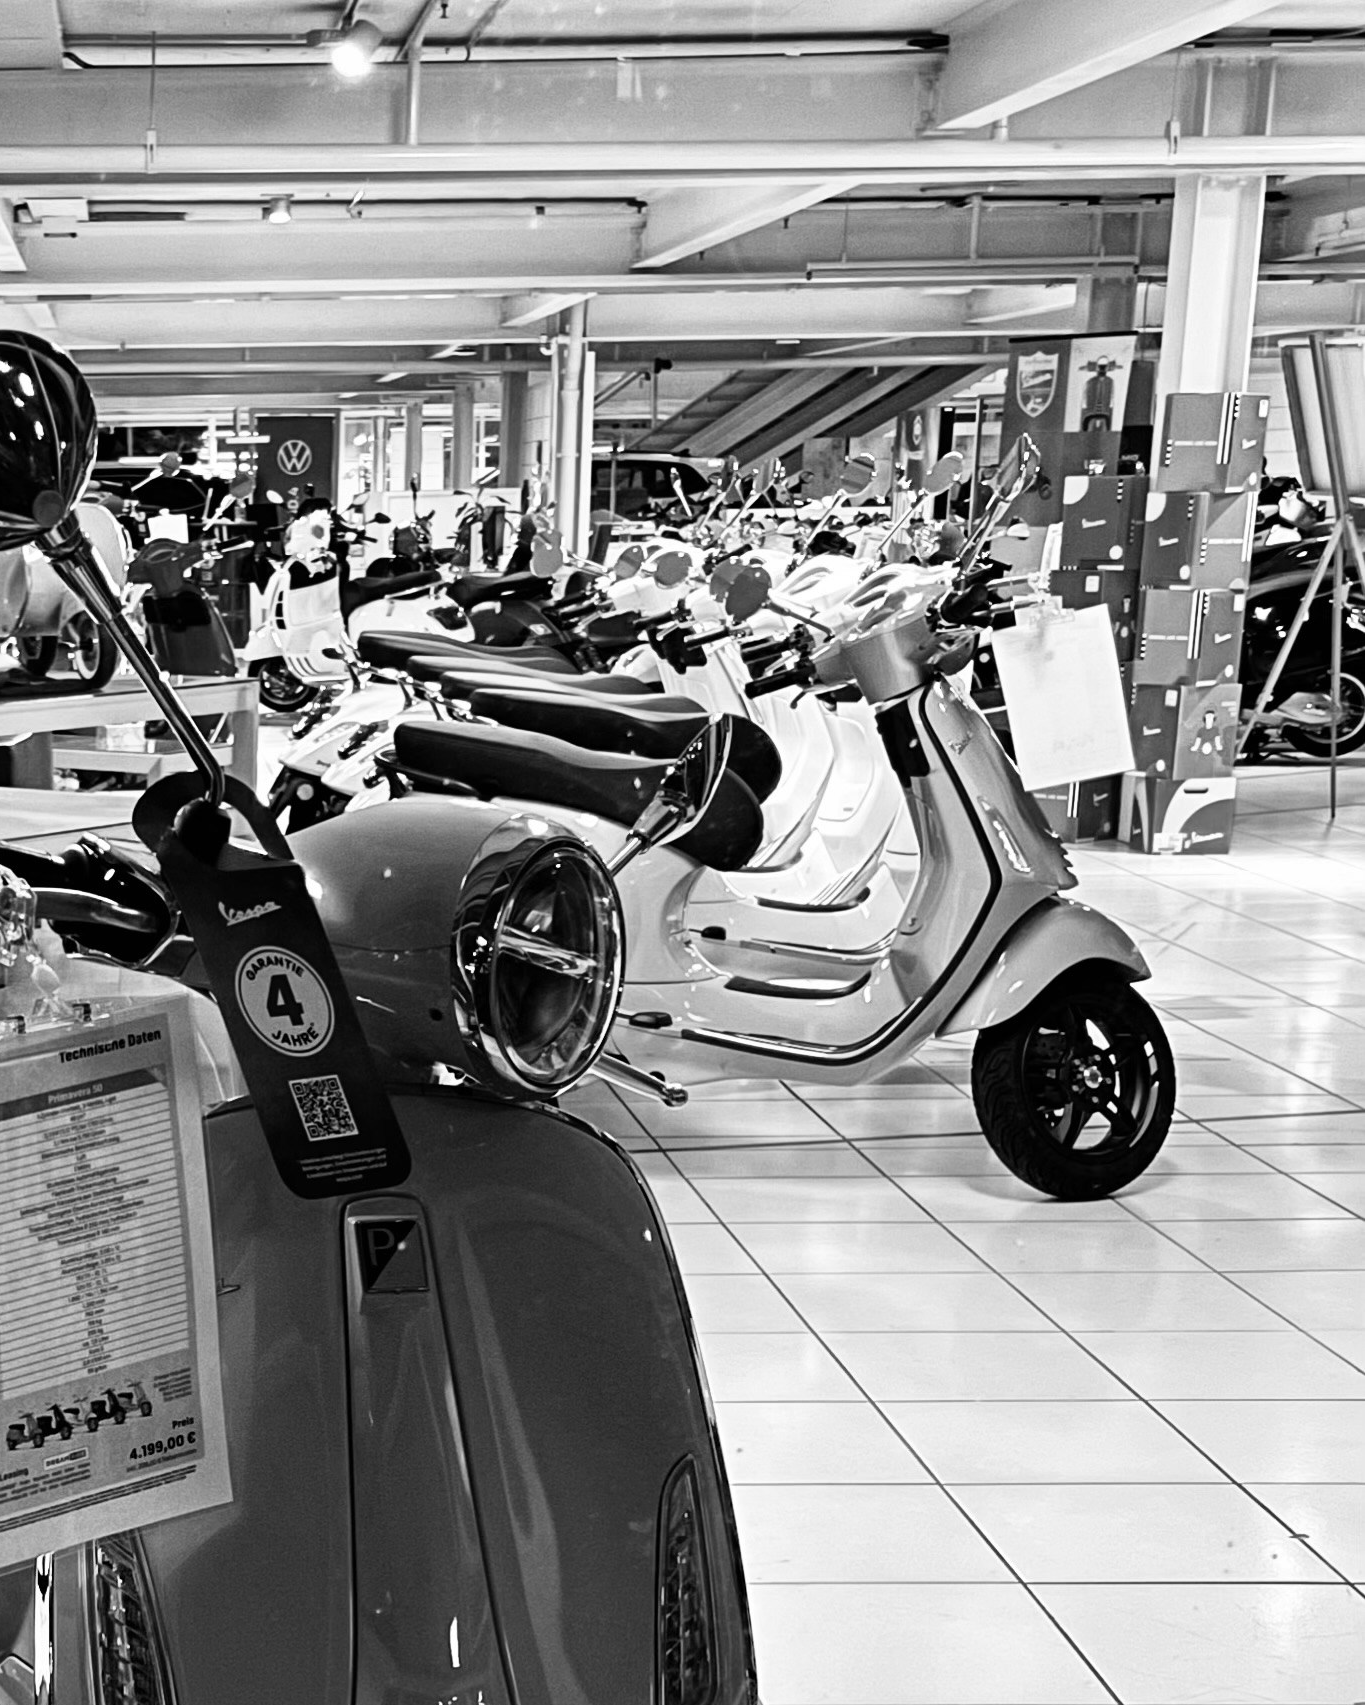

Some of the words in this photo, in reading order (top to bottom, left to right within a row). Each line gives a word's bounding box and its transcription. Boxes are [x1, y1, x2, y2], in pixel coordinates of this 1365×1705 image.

[218, 901, 282, 927] Vespa
[246, 955, 305, 982] GARANTIE
[266, 973, 305, 1027] 4
[59, 1038, 126, 1063] Technische
[127, 1029, 161, 1048] Daten
[172, 1416, 194, 1430] Preis
[129, 1434, 185, 1460] 4.199,00
[186, 1431, 196, 1444] €
